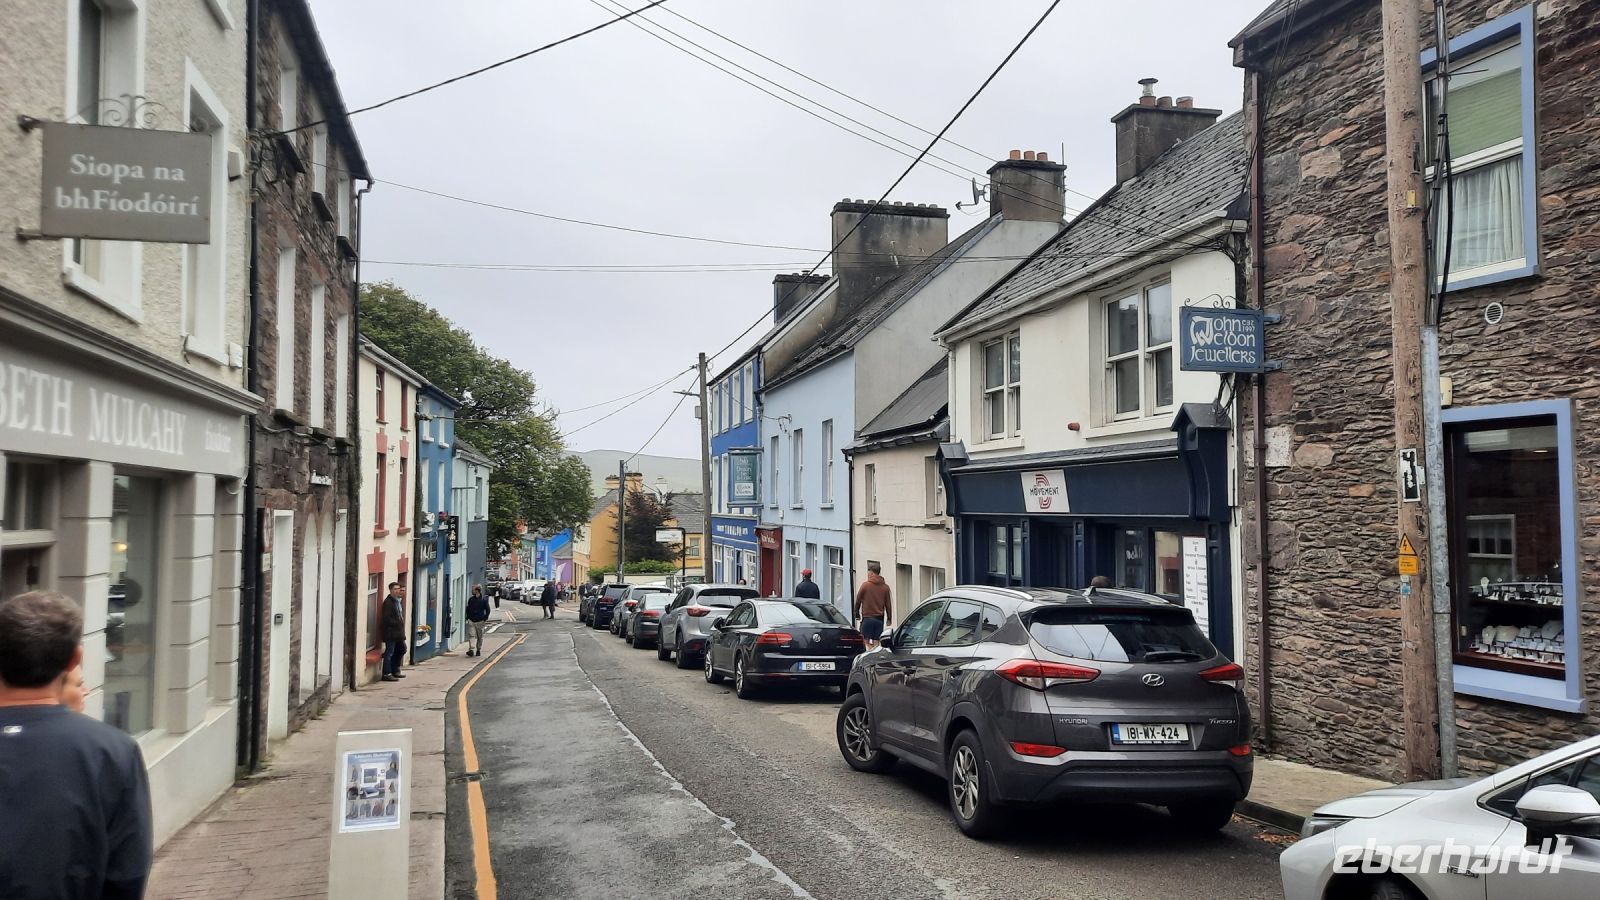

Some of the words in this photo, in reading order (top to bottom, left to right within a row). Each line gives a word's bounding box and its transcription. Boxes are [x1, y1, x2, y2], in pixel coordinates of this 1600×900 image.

[69, 153, 145, 184] Siopa
[153, 166, 186, 182] na
[55, 187, 200, 217] bhFíodóirí
[1190, 316, 1242, 332] John
[1189, 345, 1256, 364] Jewellers
[88, 387, 187, 455] MULCAHY
[1030, 486, 1060, 496] MOVEMENT
[449, 517, 457, 552] FRAMER
[1126, 727, 1180, 740] 181-WX-424
